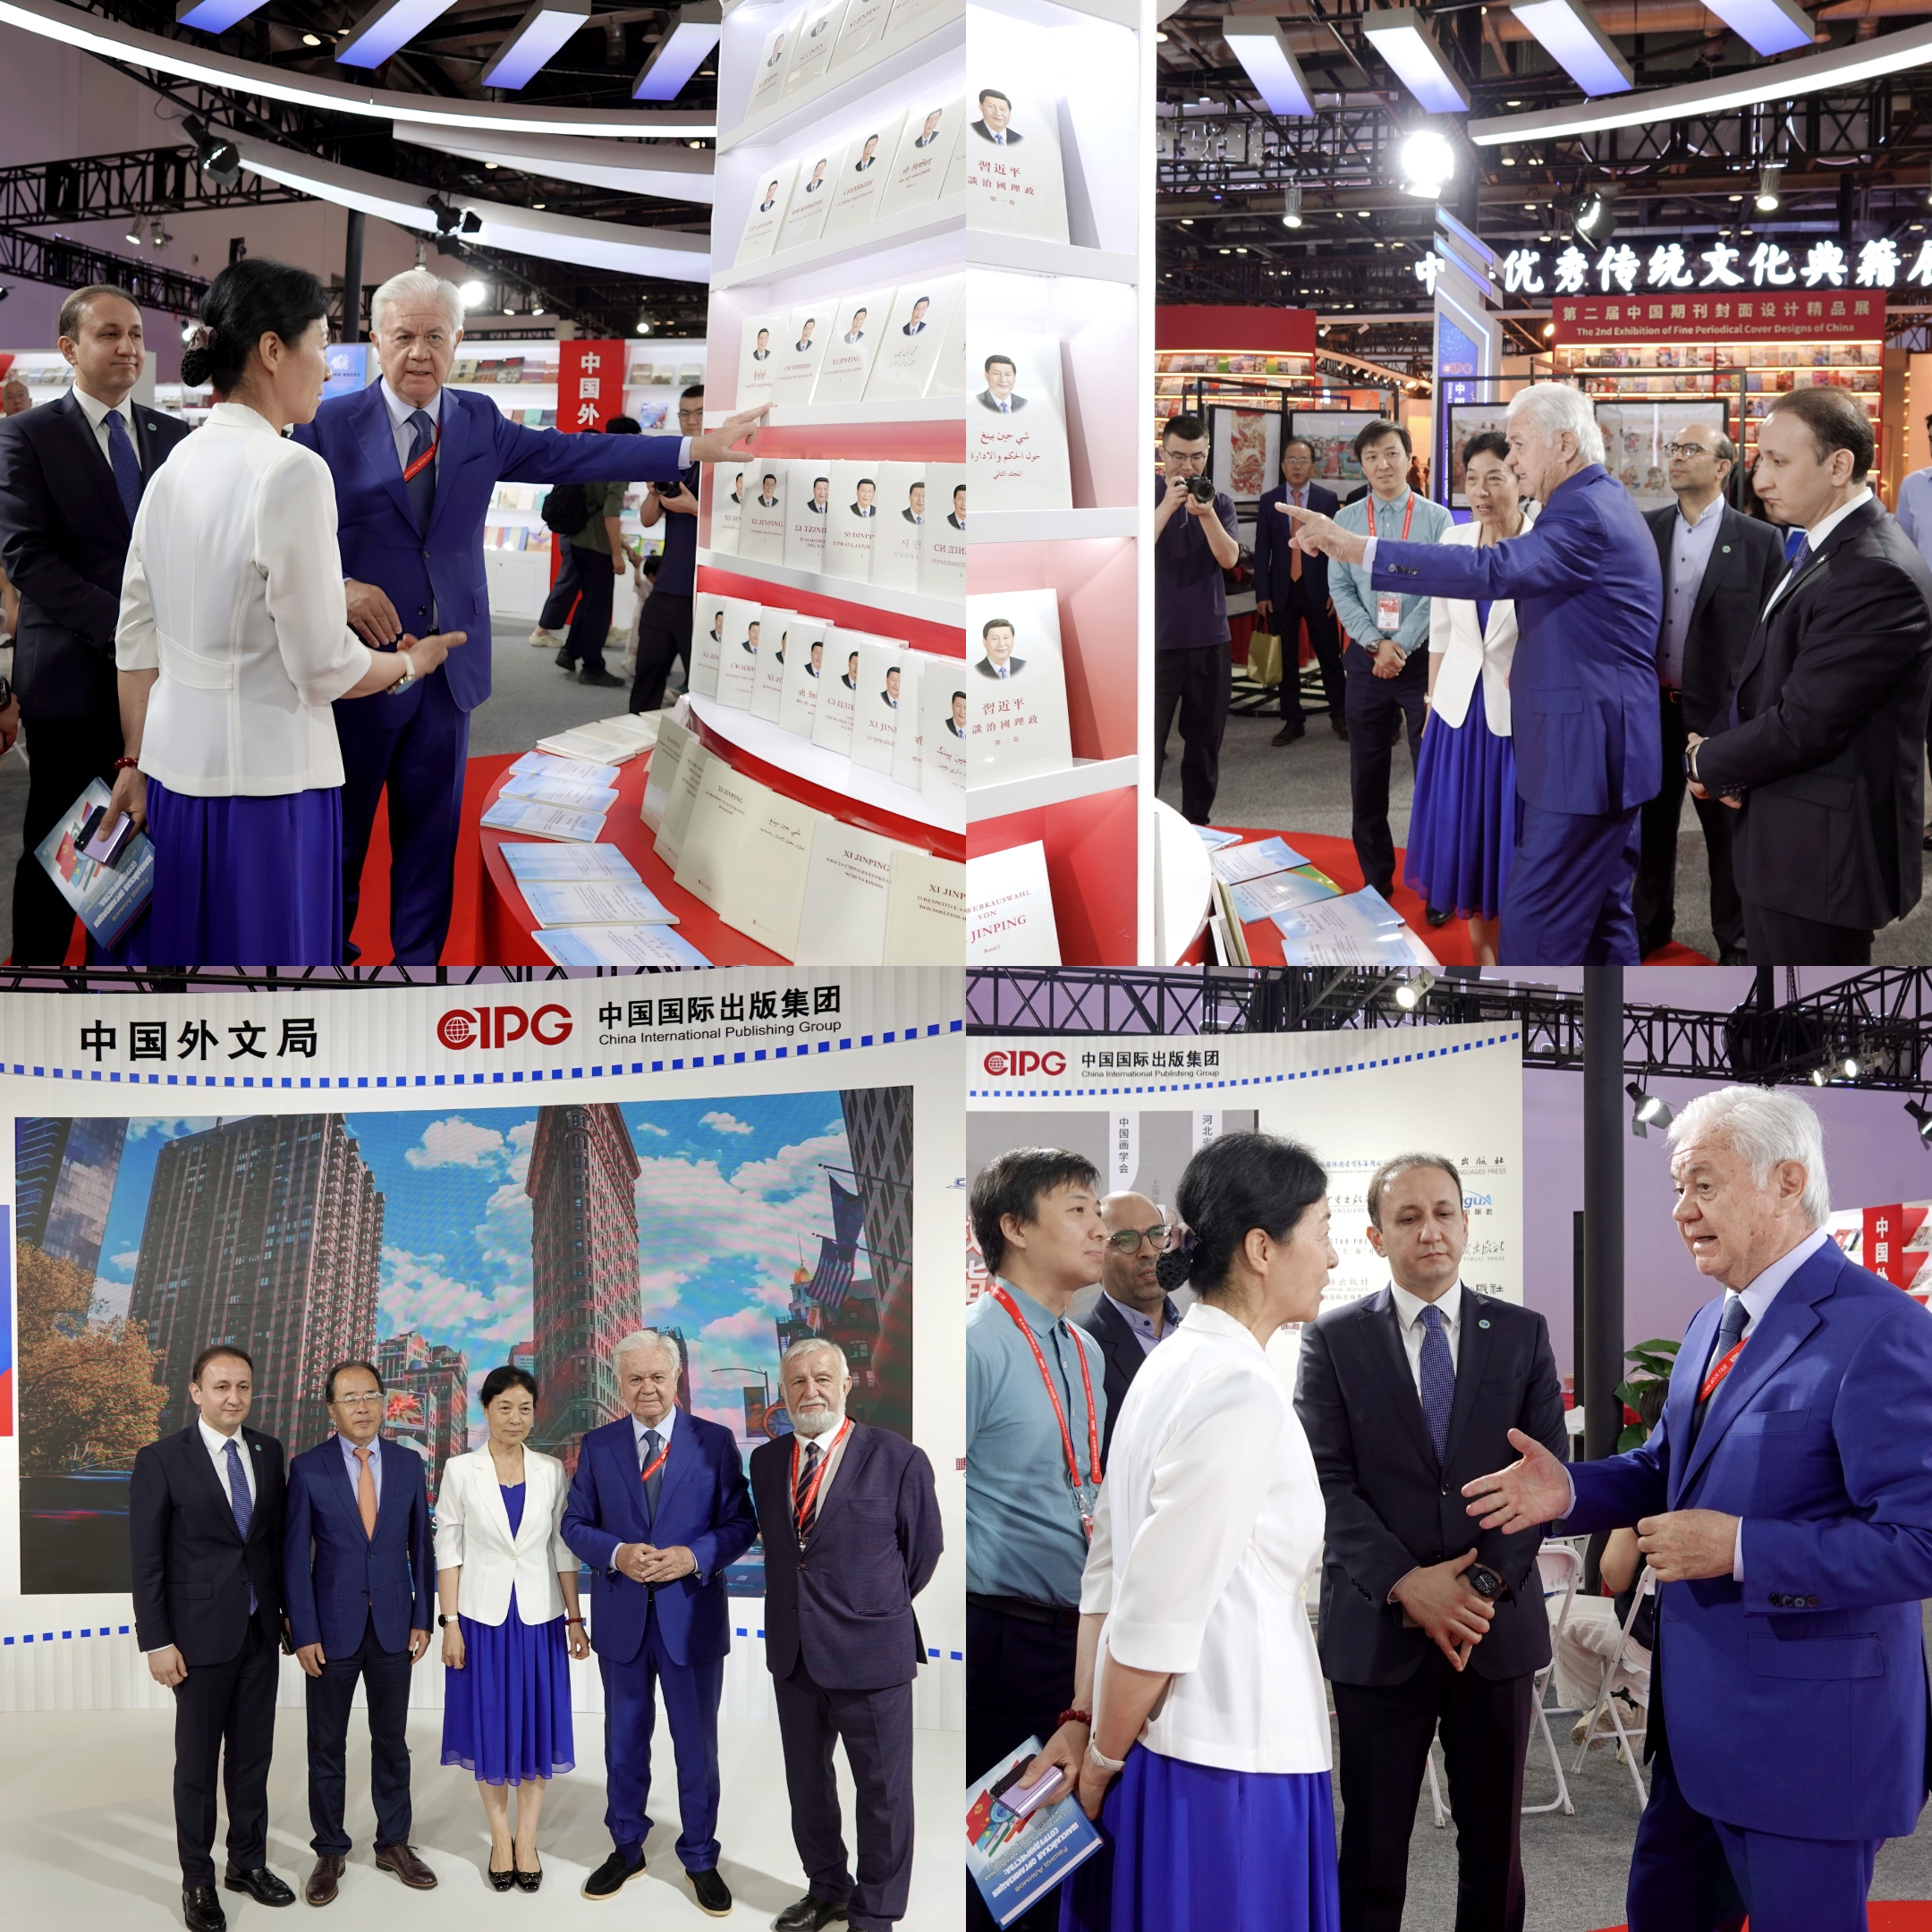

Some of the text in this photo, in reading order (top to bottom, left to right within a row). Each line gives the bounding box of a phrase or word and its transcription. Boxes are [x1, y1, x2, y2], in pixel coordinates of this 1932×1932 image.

[979, 159, 1021, 178] 習近平
[967, 175, 1035, 196] 談治國理政
[1415, 237, 1932, 296] 中优秀传统文化典籍
[1563, 301, 1870, 322] 第二届中国期刊封面设计精品展
[1577, 323, 1854, 336] The 2nd Exhibition of Fine Periodical Cover Designs of China
[1442, 363, 1474, 375] CIPG
[577, 351, 600, 427] 中国外
[980, 431, 1030, 445] شي جين بينغ
[1004, 452, 1023, 464] الحكم
[1026, 452, 1040, 462] حول
[758, 520, 784, 528] JINPING
[947, 545, 966, 555] ДЗИ
[982, 697, 1025, 716] 習近平
[869, 719, 878, 728] XI
[971, 715, 1038, 735] 談治國理政
[994, 736, 1020, 746] 第二卷
[843, 850, 891, 872] XI JINPING
[929, 884, 966, 900] XI JINP
[966, 890, 1032, 914] WERKAUSWAHL
[978, 910, 997, 920] VON
[970, 914, 1027, 944] JINPING
[984, 945, 997, 954] Band
[599, 985, 842, 1030] 中国国际出版集团
[436, 1004, 573, 1051] CIPG
[598, 1019, 842, 1046] China International Publishing Group
[80, 1017, 318, 1062] 中国外文局
[984, 1050, 1067, 1076] CIPG
[1081, 1049, 1220, 1069] 中国国际出版集团
[1081, 1069, 1220, 1079] China International Publishing Group
[1119, 1117, 1129, 1174] 中国画学会
[1461, 1156, 1504, 1166] 出版社
[1458, 1167, 1506, 1176] NGUAGES PRESS
[1875, 1216, 1889, 1282] 中国外
[1717, 1363, 1728, 1375] FAIR
[1048, 1384, 1056, 1400] BOOK
[990, 1821, 1080, 1899] ШАНХАЙСКАЯ ОРГАНИЗАЦИЯ
[1003, 1826, 1060, 1876] СОТРУДНИЧЕСТВА:
[984, 1852, 1019, 1882] механизма
[1013, 1845, 1069, 1893] Рашид Алимов
